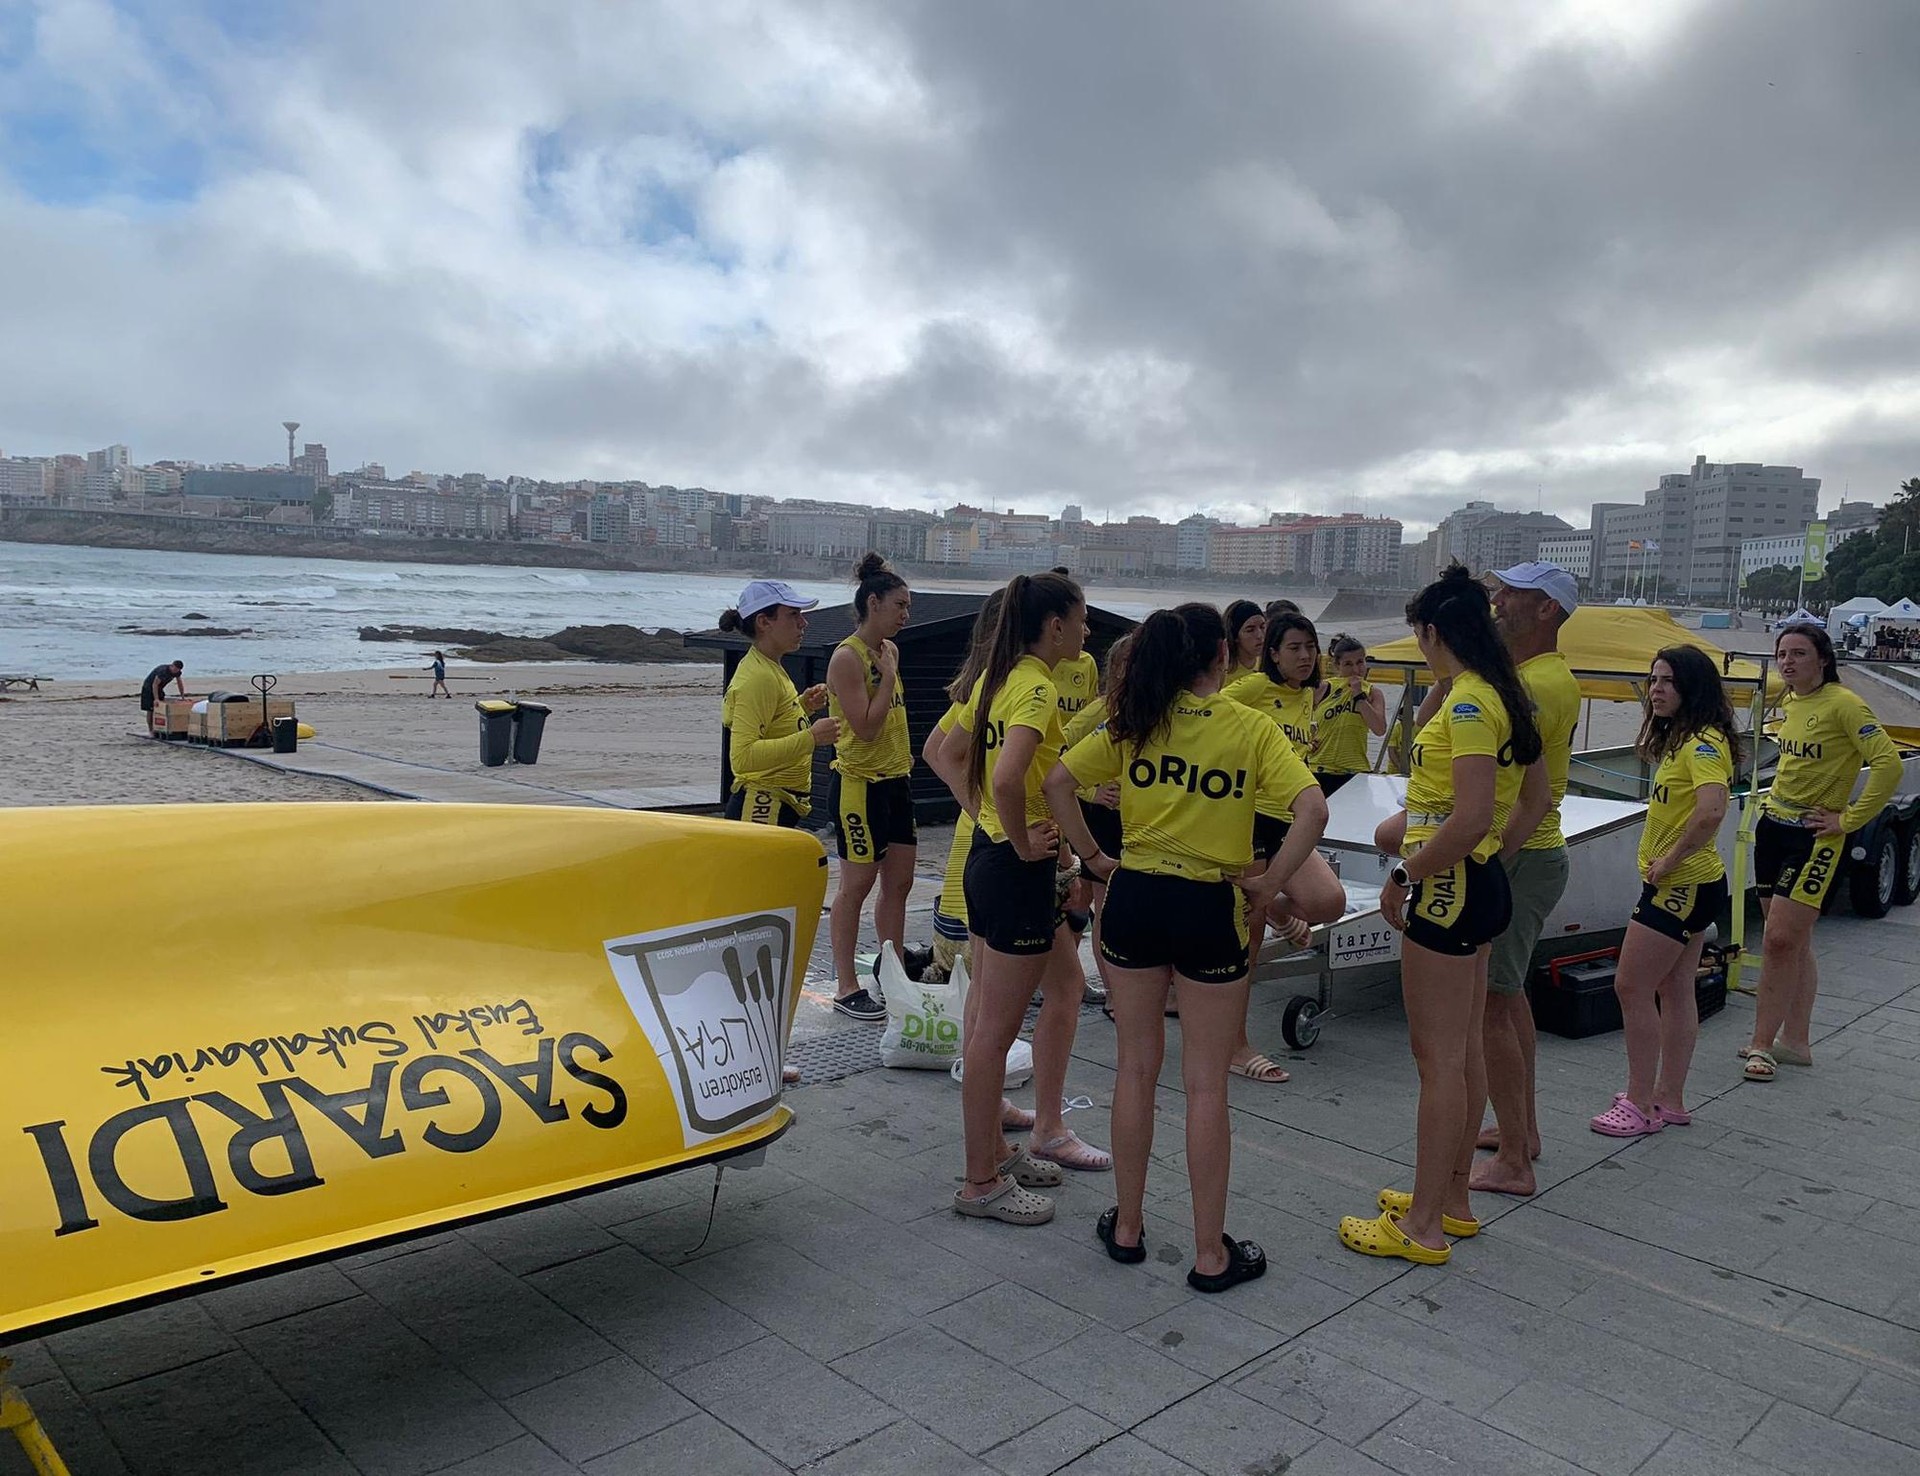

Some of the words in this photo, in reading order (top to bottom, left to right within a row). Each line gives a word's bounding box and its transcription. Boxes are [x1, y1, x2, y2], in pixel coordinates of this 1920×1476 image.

[1129, 755, 1247, 799] ORIO!
[1337, 930, 1391, 948] taryc
[413, 999, 544, 1050] Euskal
[676, 1017, 753, 1070] LIGA
[101, 1021, 409, 1102] Sukaldariak
[698, 1066, 763, 1099] euskotren
[22, 1032, 628, 1237] SAGARDI
